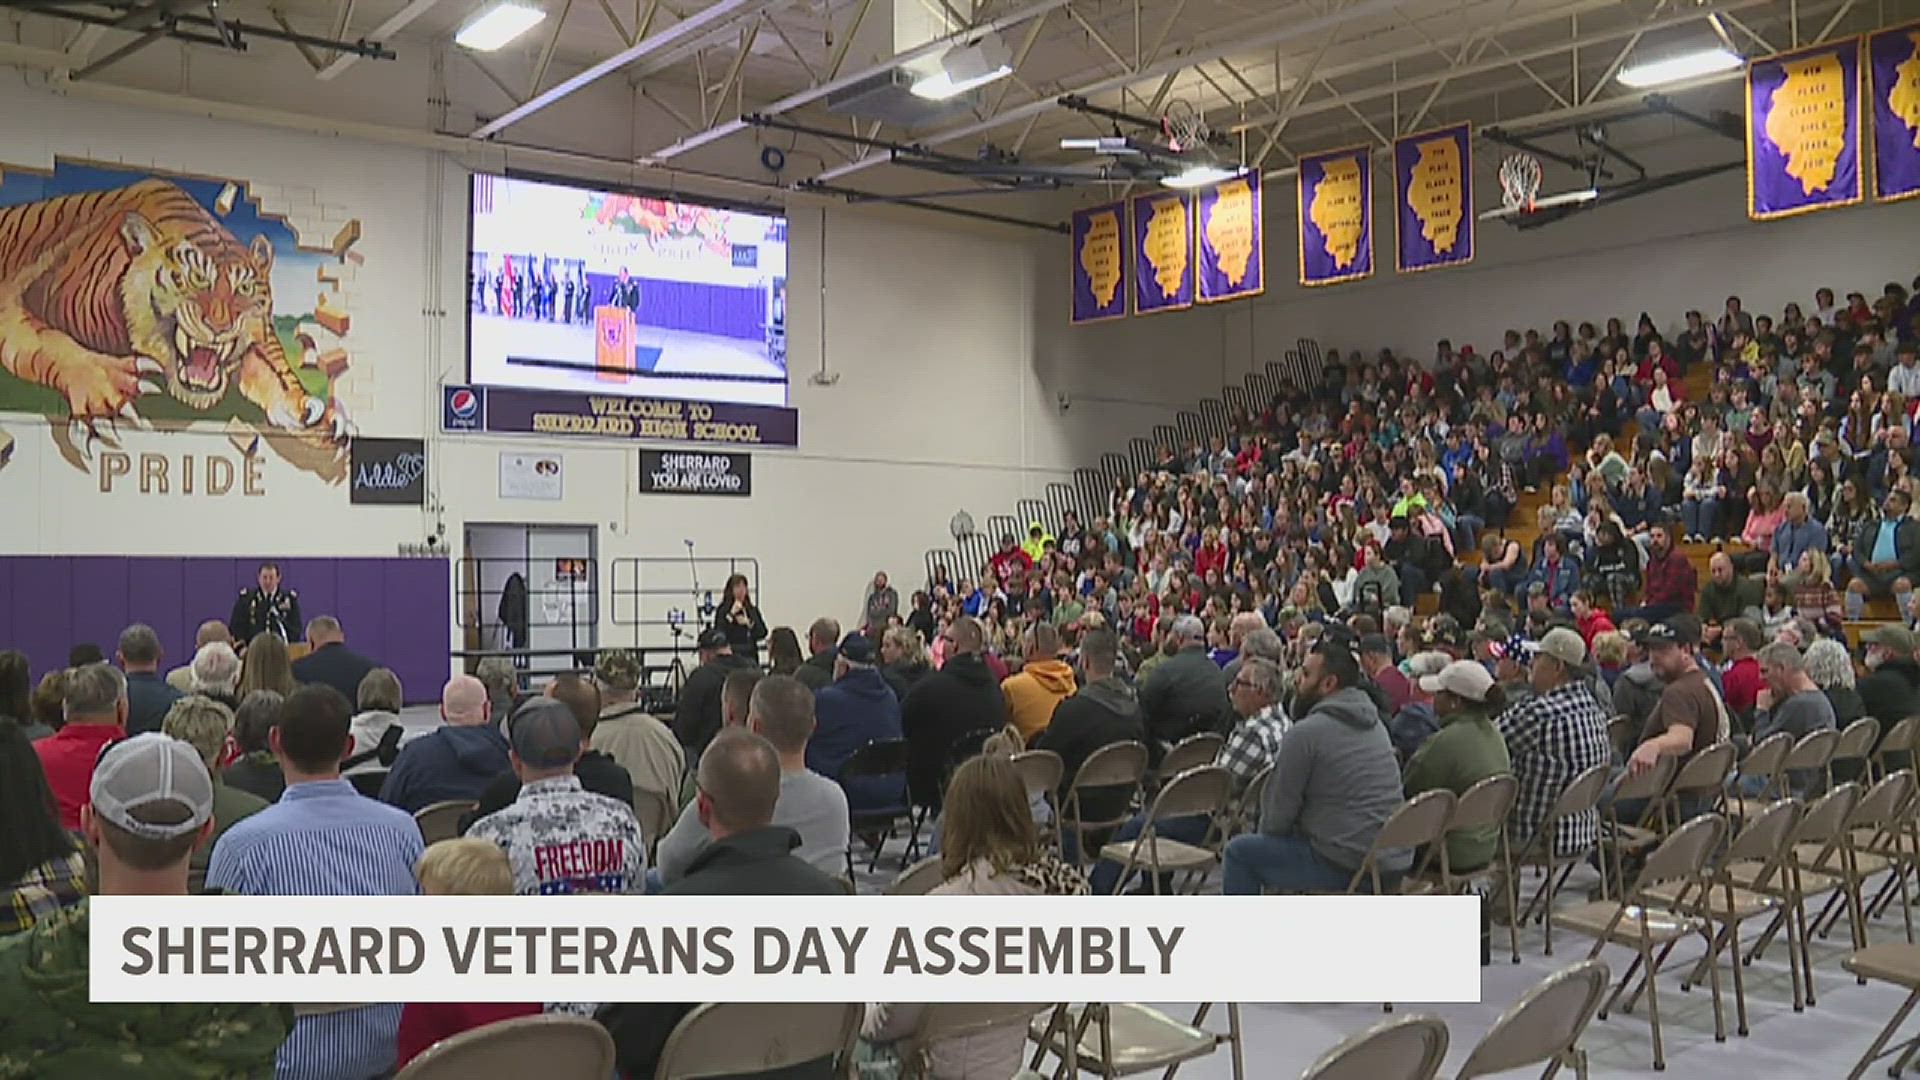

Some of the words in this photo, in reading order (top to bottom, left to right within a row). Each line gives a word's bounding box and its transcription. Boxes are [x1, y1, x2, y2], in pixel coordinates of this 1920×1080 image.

[588, 396, 683, 419] WELCOME
[688, 403, 712, 421] TO
[533, 412, 635, 435] SHERRARD
[639, 419, 688, 438] HIGH
[694, 422, 761, 442] SCHOOL
[100, 452, 266, 496] PRIDE
[661, 453, 731, 471] SHERRARD
[354, 463, 407, 490] Addie
[651, 471, 679, 488] YOU
[681, 473, 701, 488] ARE
[703, 474, 741, 490] LOVED
[534, 839, 624, 881] FREEDOM
